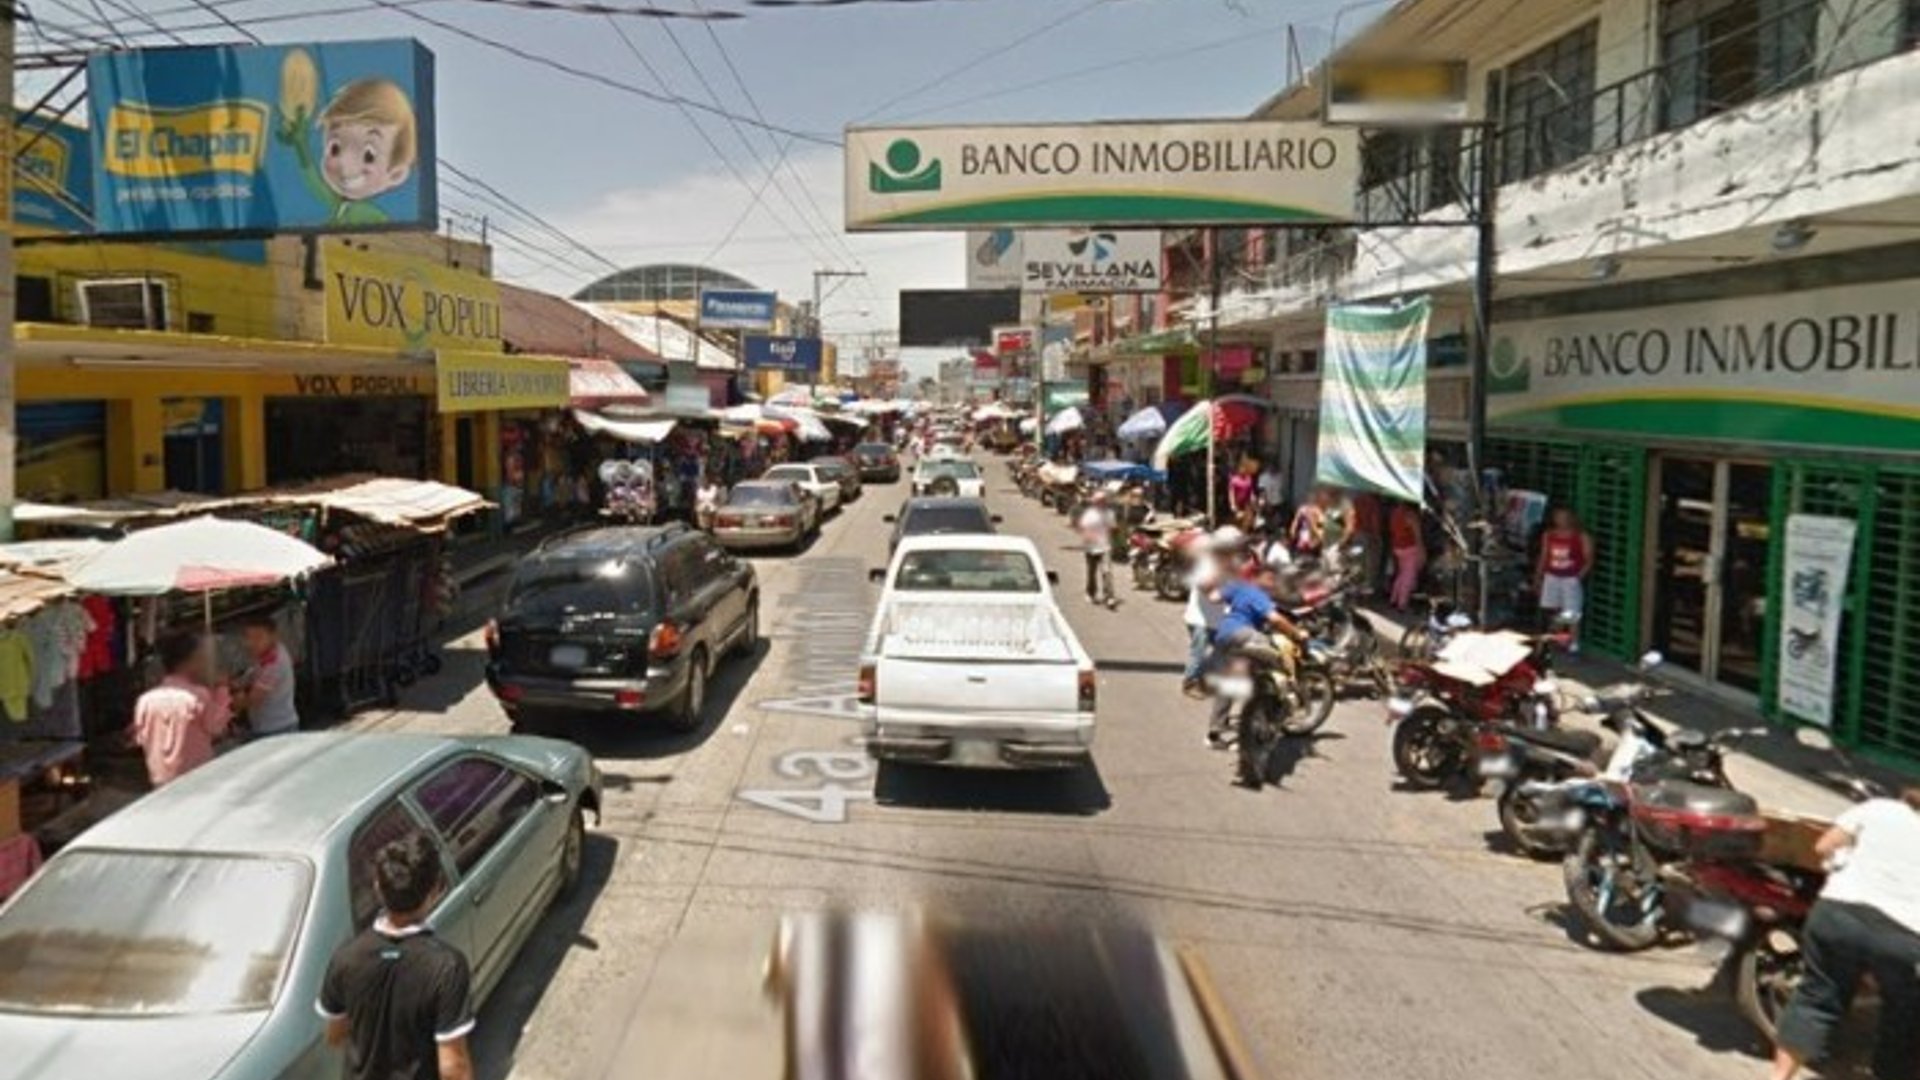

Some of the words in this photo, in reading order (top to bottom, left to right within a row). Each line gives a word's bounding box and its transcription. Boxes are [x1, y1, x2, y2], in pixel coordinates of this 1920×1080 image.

[116, 130, 141, 158] El
[961, 143, 1080, 175] BANCO
[1092, 138, 1337, 174] INMOBILIARIO
[1026, 260, 1156, 281] SEVILLANA
[1044, 279, 1140, 288] FARMACIA
[336, 272, 407, 330] VOX
[423, 290, 501, 339] POPULI
[1543, 328, 1670, 377] BANCO
[1684, 314, 1920, 374] INMOBIL
[293, 373, 340, 394] VOX
[351, 375, 418, 395] POPULI
